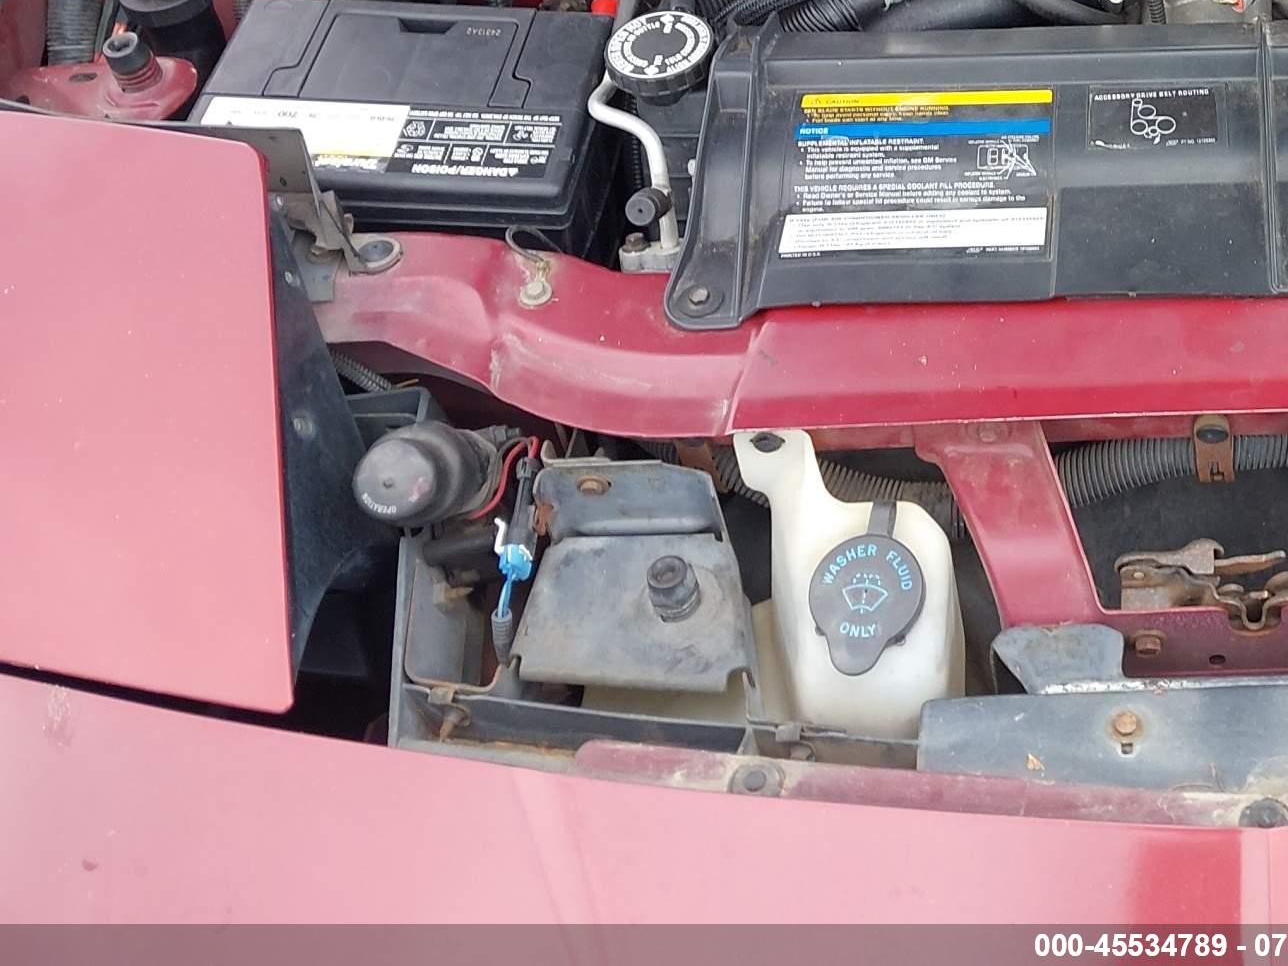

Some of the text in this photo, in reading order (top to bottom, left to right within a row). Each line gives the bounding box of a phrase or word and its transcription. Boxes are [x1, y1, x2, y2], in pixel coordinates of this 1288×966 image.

[1094, 89, 1210, 101] ACCESSORY DRIVE BELT ROUTING
[800, 127, 828, 135] NOTICE
[412, 164, 509, 177] DANGER/POISON
[362, 492, 397, 514] OPERATION
[822, 543, 913, 591] WASHER FLUID
[839, 622, 877, 638] ONLY
